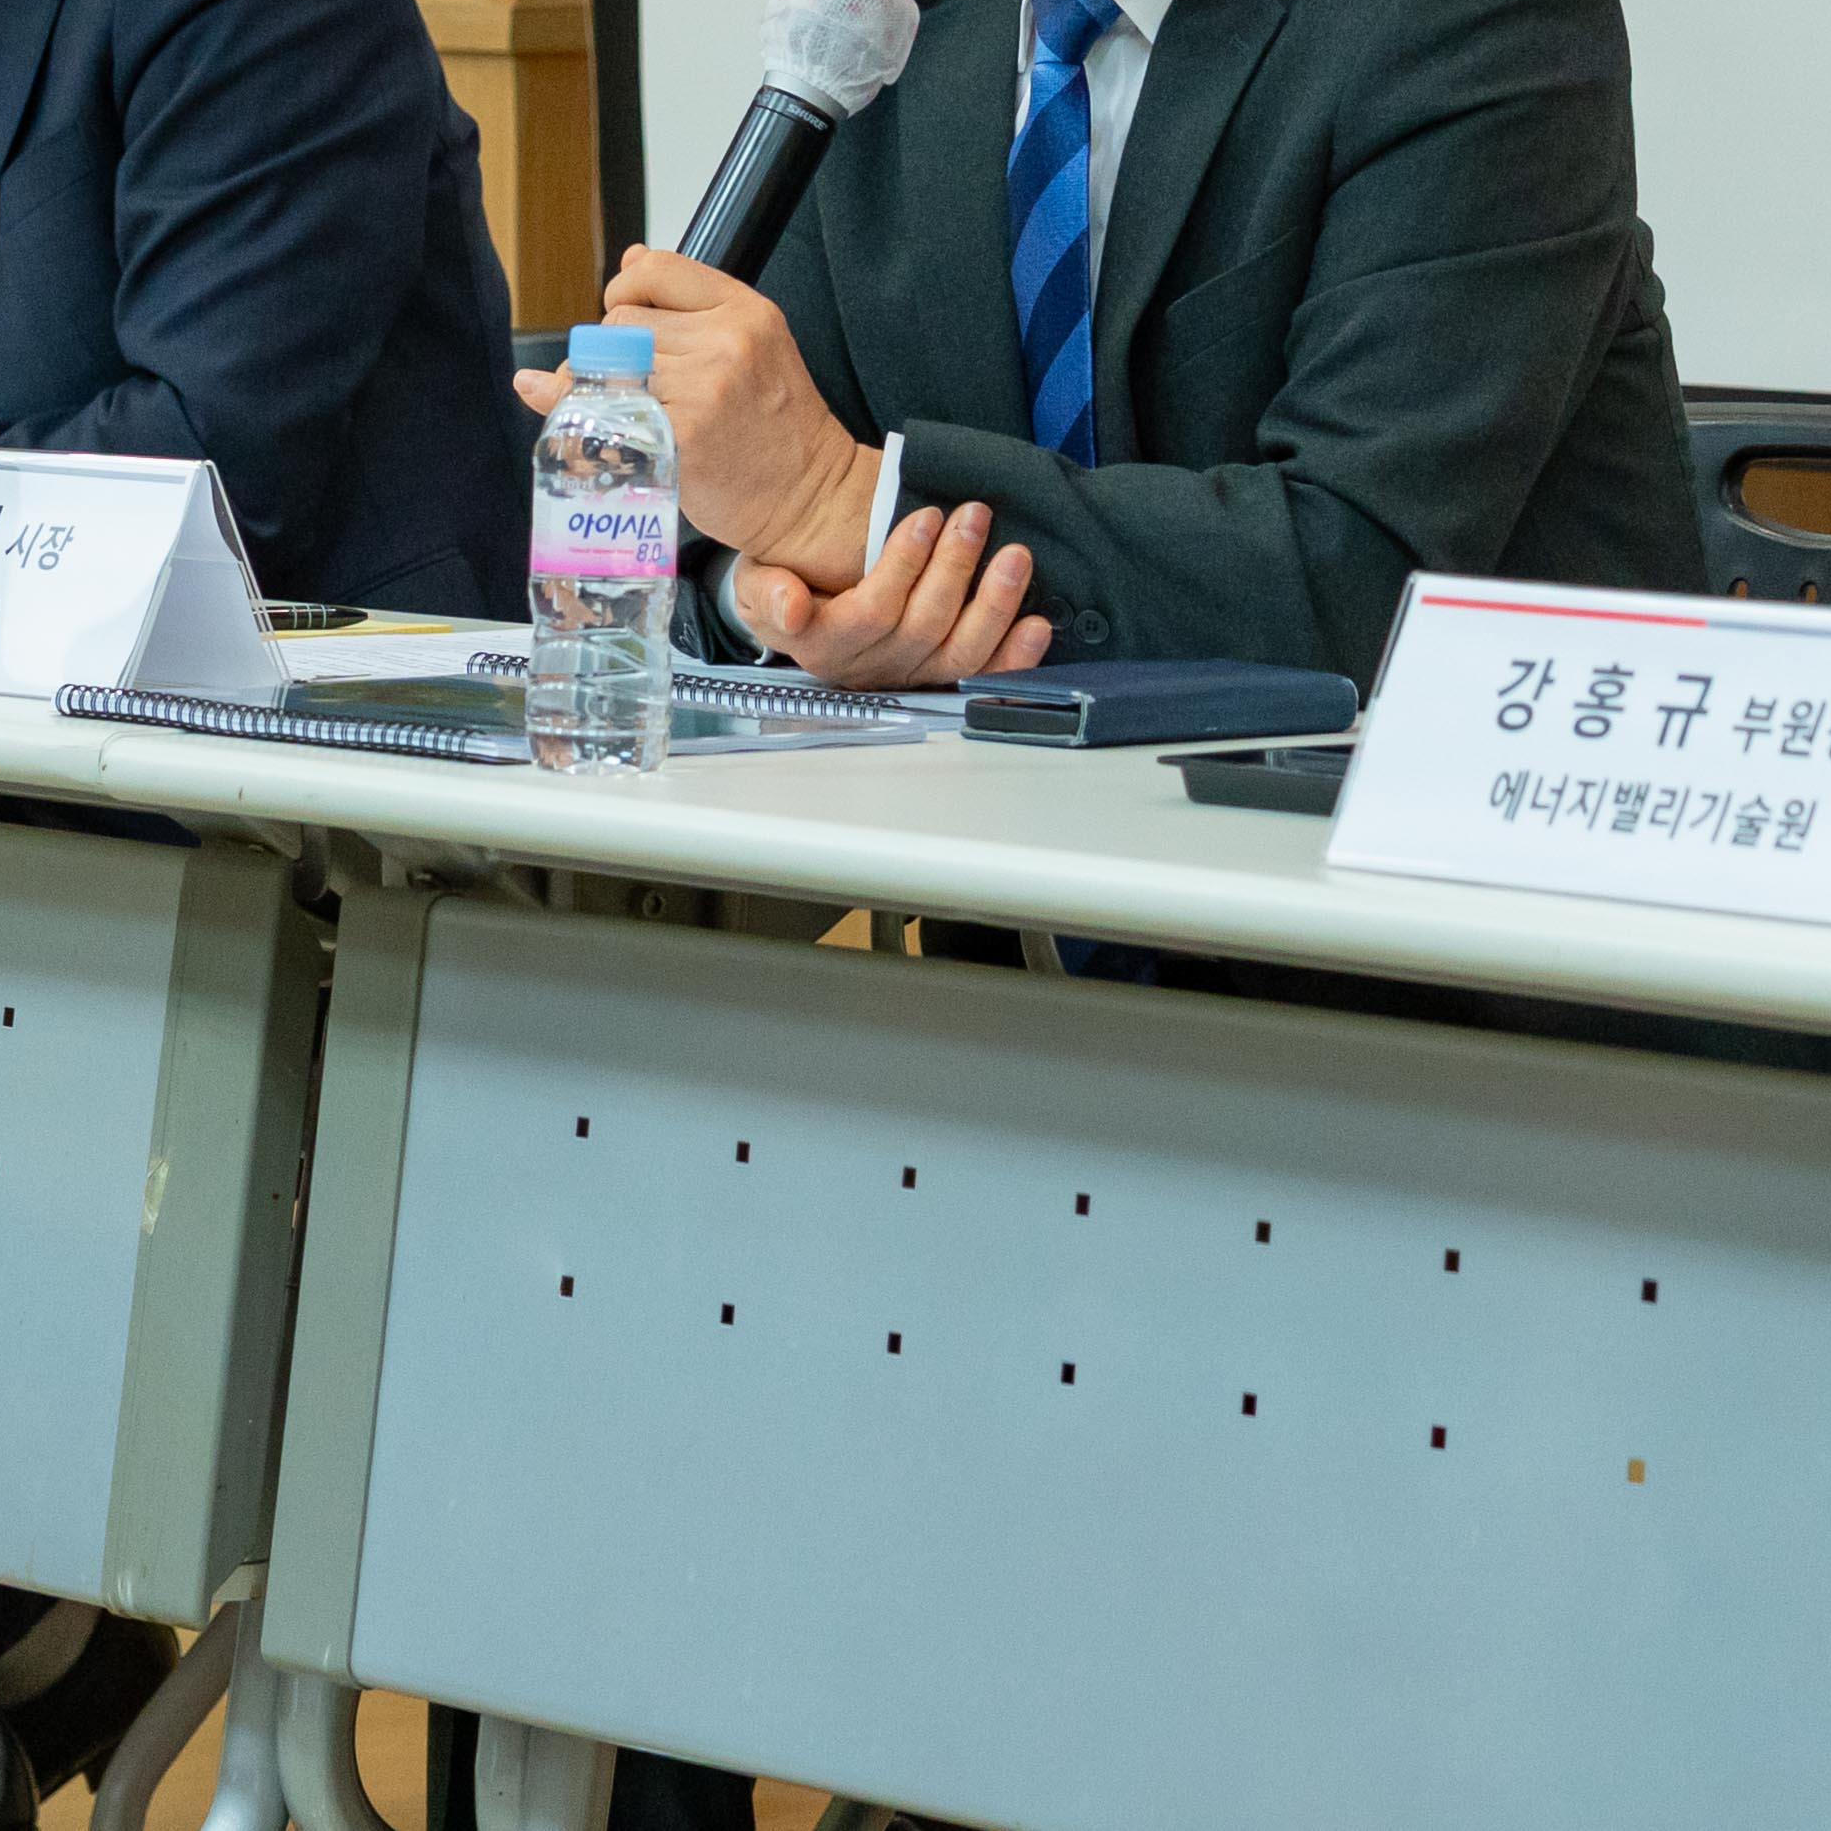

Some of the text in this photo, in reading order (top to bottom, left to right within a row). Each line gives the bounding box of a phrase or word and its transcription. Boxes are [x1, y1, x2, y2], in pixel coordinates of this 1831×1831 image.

[787, 103, 829, 131] SHURE
[4, 521, 74, 571] 시장
[1489, 768, 1818, 853] 에너지밸리기술원
